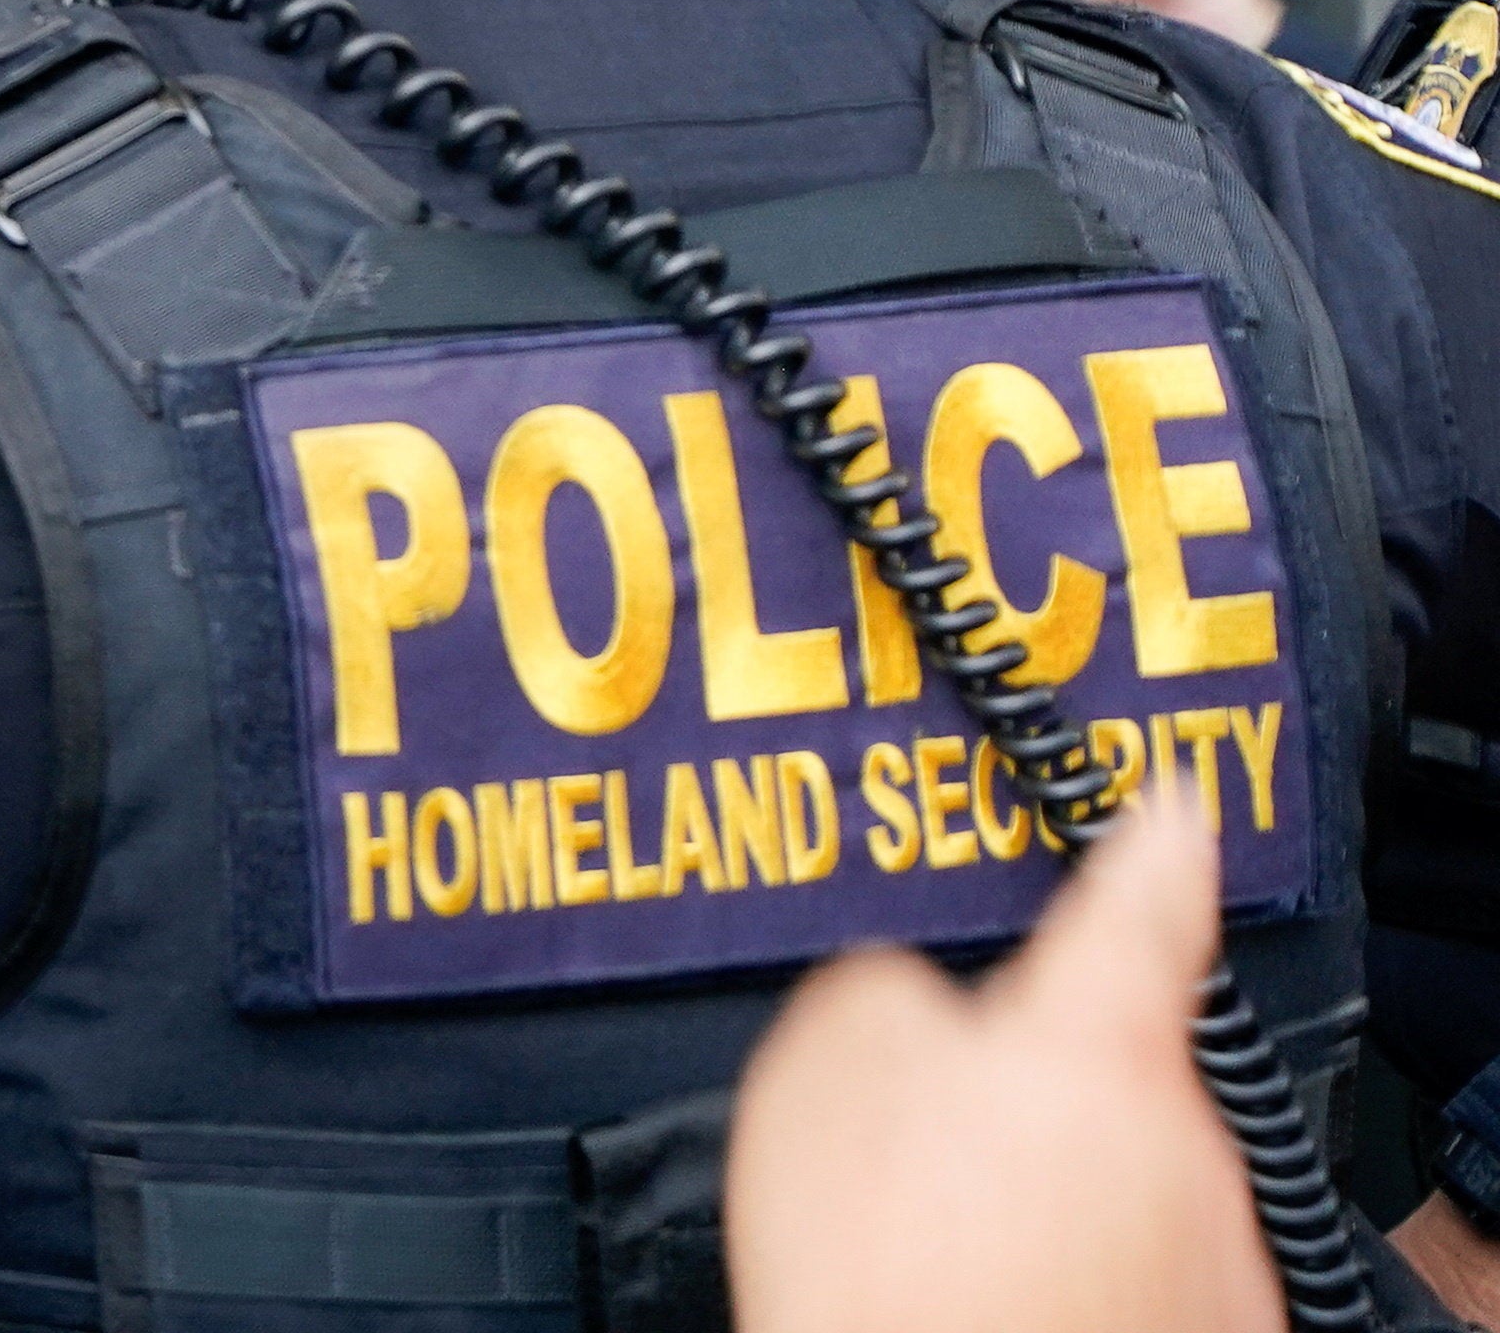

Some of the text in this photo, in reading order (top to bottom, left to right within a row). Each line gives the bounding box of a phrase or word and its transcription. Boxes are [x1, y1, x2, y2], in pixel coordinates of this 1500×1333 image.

[291, 343, 1279, 756] POLICE
[342, 700, 1283, 923] HOMELAND SECRITY
